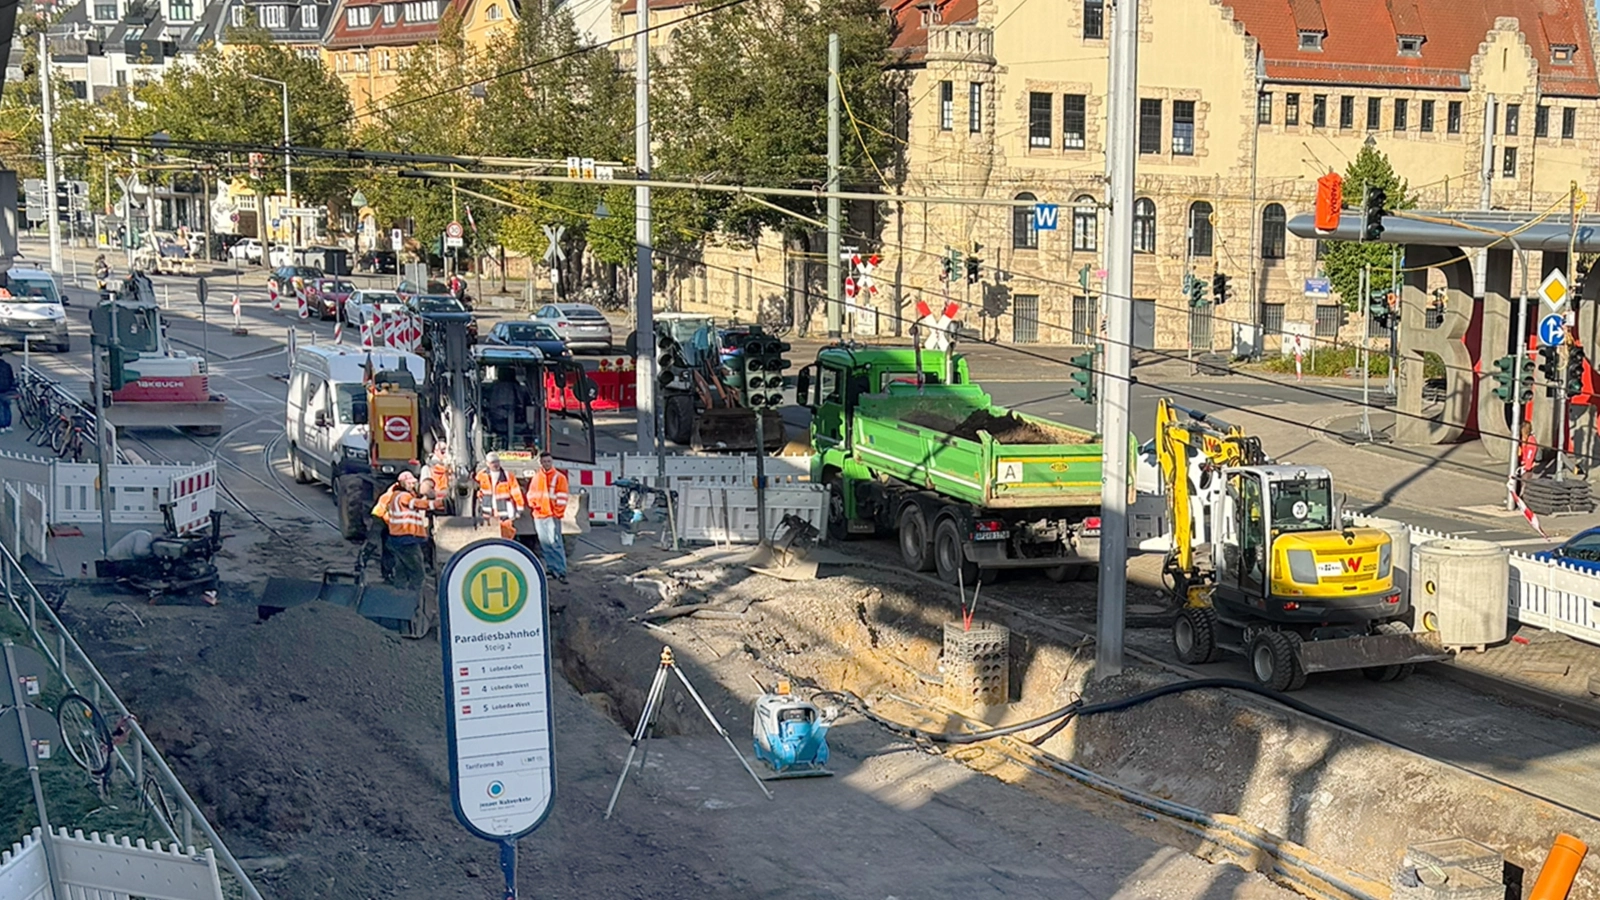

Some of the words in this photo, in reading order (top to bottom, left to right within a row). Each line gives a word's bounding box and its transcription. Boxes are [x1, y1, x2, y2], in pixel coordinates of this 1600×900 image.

[1036, 207, 1057, 228] W
[1005, 465, 1016, 480] A
[1296, 504, 1305, 515] 20
[481, 571, 509, 609] H
[454, 628, 540, 644] Paradiesbahnhof
[484, 644, 506, 652] Steig
[507, 642, 512, 650] 2
[481, 685, 487, 693] 4
[483, 704, 489, 712] 5
[465, 761, 494, 770] Tarifzone
